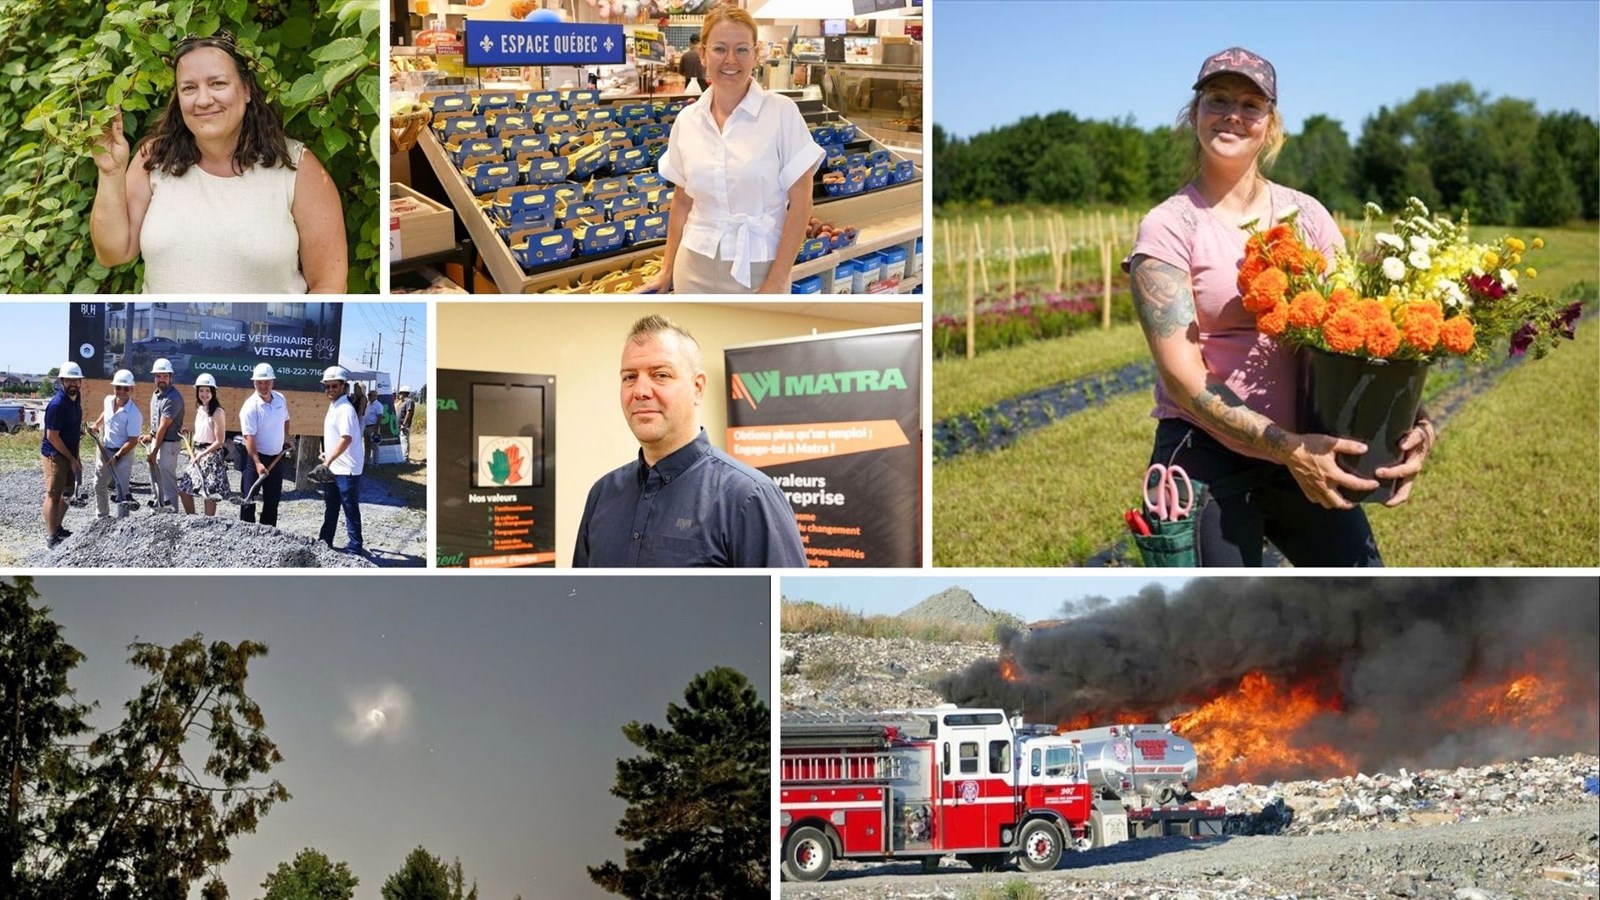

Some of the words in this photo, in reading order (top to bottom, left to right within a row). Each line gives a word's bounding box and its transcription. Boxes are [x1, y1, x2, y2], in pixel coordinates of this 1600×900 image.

[501, 35, 549, 53] ESPACE
[554, 32, 598, 53] QUÉBEC
[254, 347, 312, 358] VETSANTÉ
[194, 362, 228, 370] LOCAUX
[230, 363, 236, 371] À
[277, 367, 324, 376] 418-222-716
[785, 368, 908, 397] MATRA
[828, 426, 867, 440] emploi
[773, 473, 826, 488] valeurs
[469, 494, 486, 503] Nos
[487, 493, 517, 502] valeurs
[785, 490, 845, 507] reprise
[807, 524, 861, 535] changement
